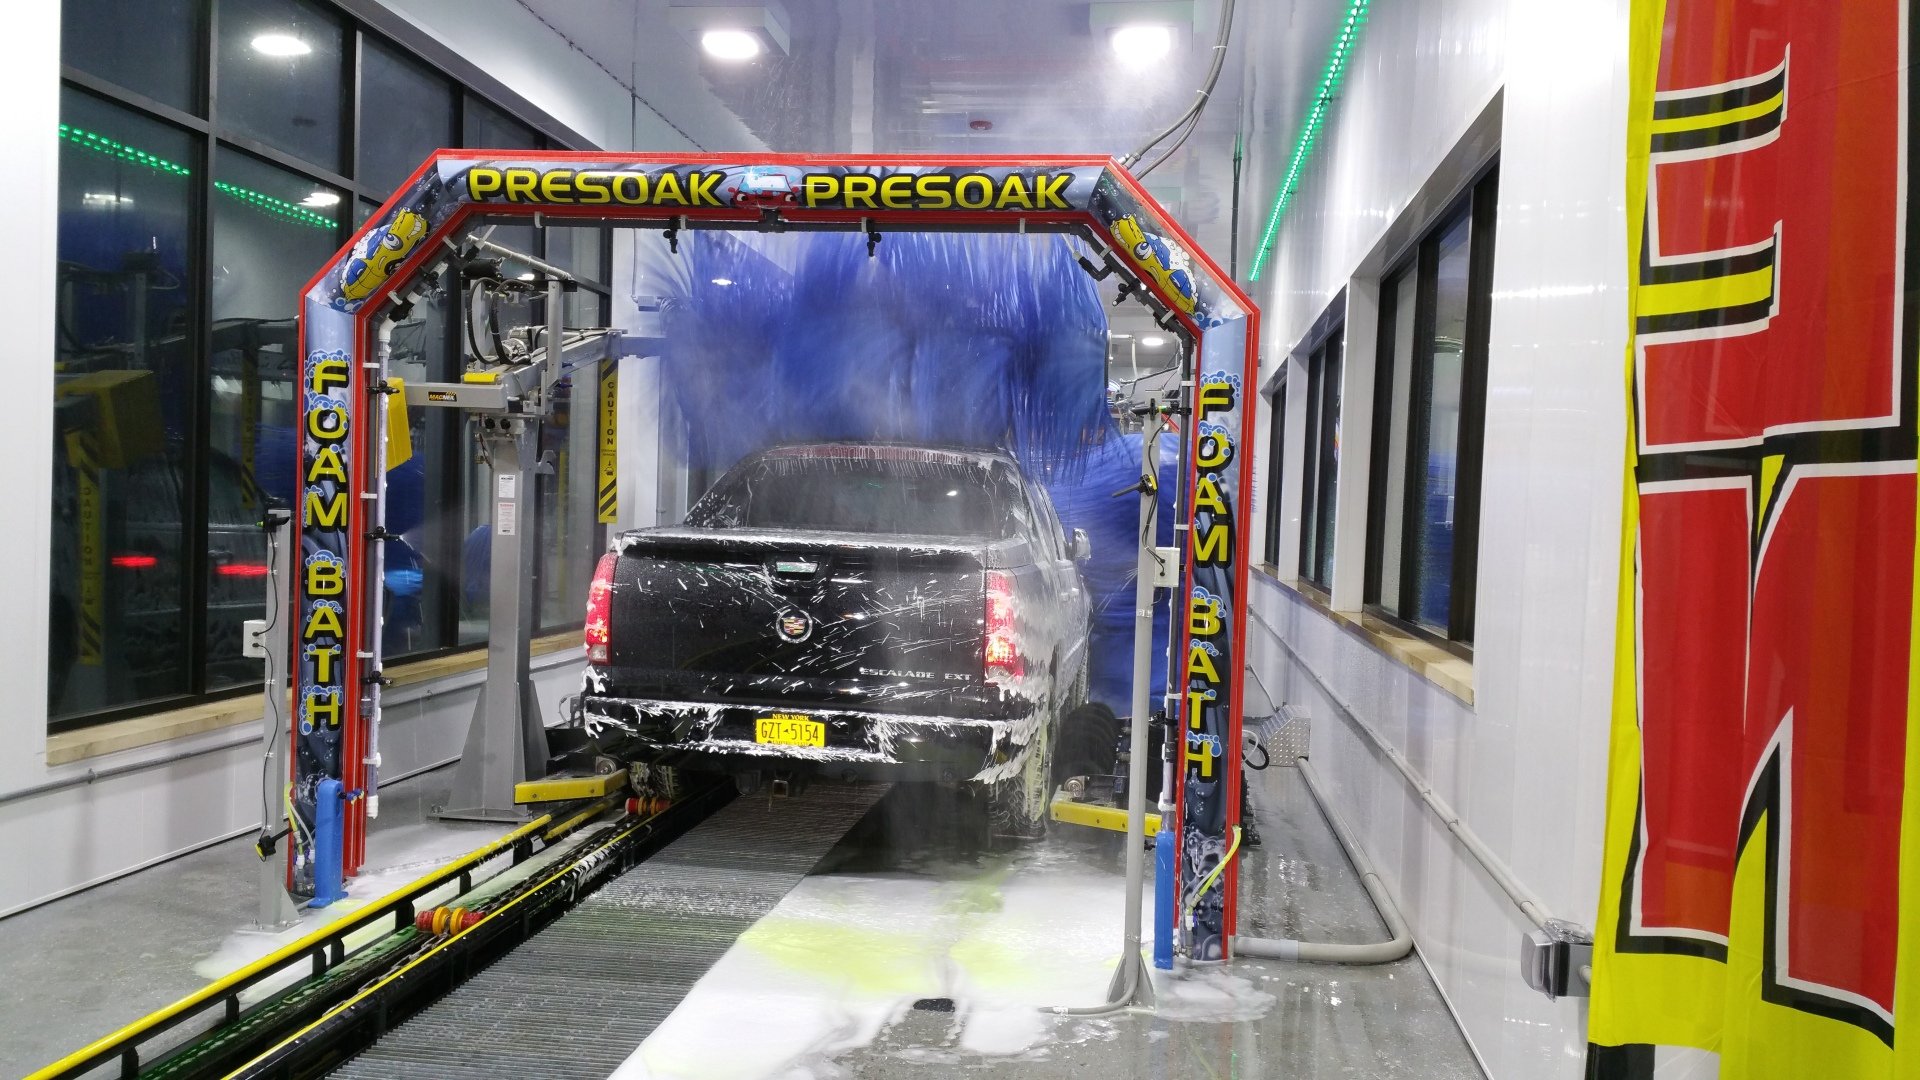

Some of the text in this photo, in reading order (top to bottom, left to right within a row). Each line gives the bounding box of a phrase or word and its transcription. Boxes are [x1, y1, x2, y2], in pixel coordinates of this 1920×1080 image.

[468, 167, 1071, 210] PRESOAK PRESOAK
[606, 381, 615, 446] CAUTION
[304, 358, 349, 727] FOAM BATH
[1184, 381, 1232, 778] FOAM BATH
[860, 667, 973, 681] ESCALADE EXT
[772, 713, 810, 722] NEW YORK
